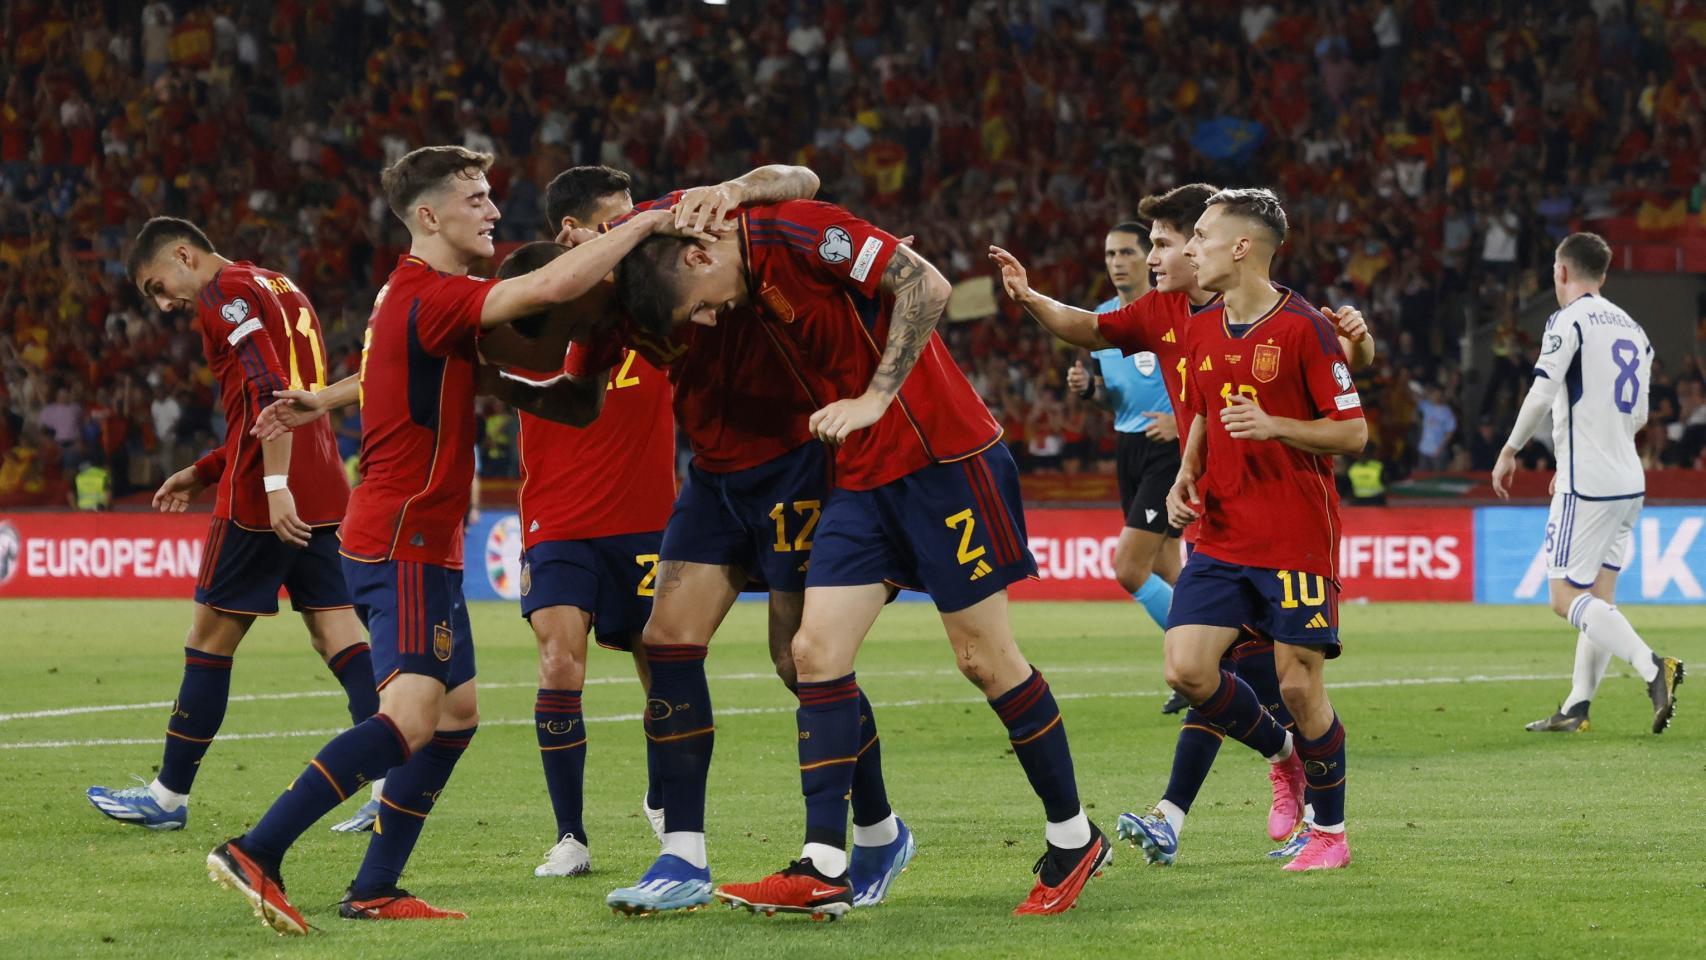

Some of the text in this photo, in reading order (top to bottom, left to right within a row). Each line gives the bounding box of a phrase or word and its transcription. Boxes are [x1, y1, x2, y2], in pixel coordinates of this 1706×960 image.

[1611, 338, 1640, 414] 8
[768, 499, 821, 552] 12
[944, 507, 986, 565] 2
[1545, 522, 1557, 553] 8
[27, 537, 201, 578] EUROPEAN
[1276, 569, 1326, 608] 10
